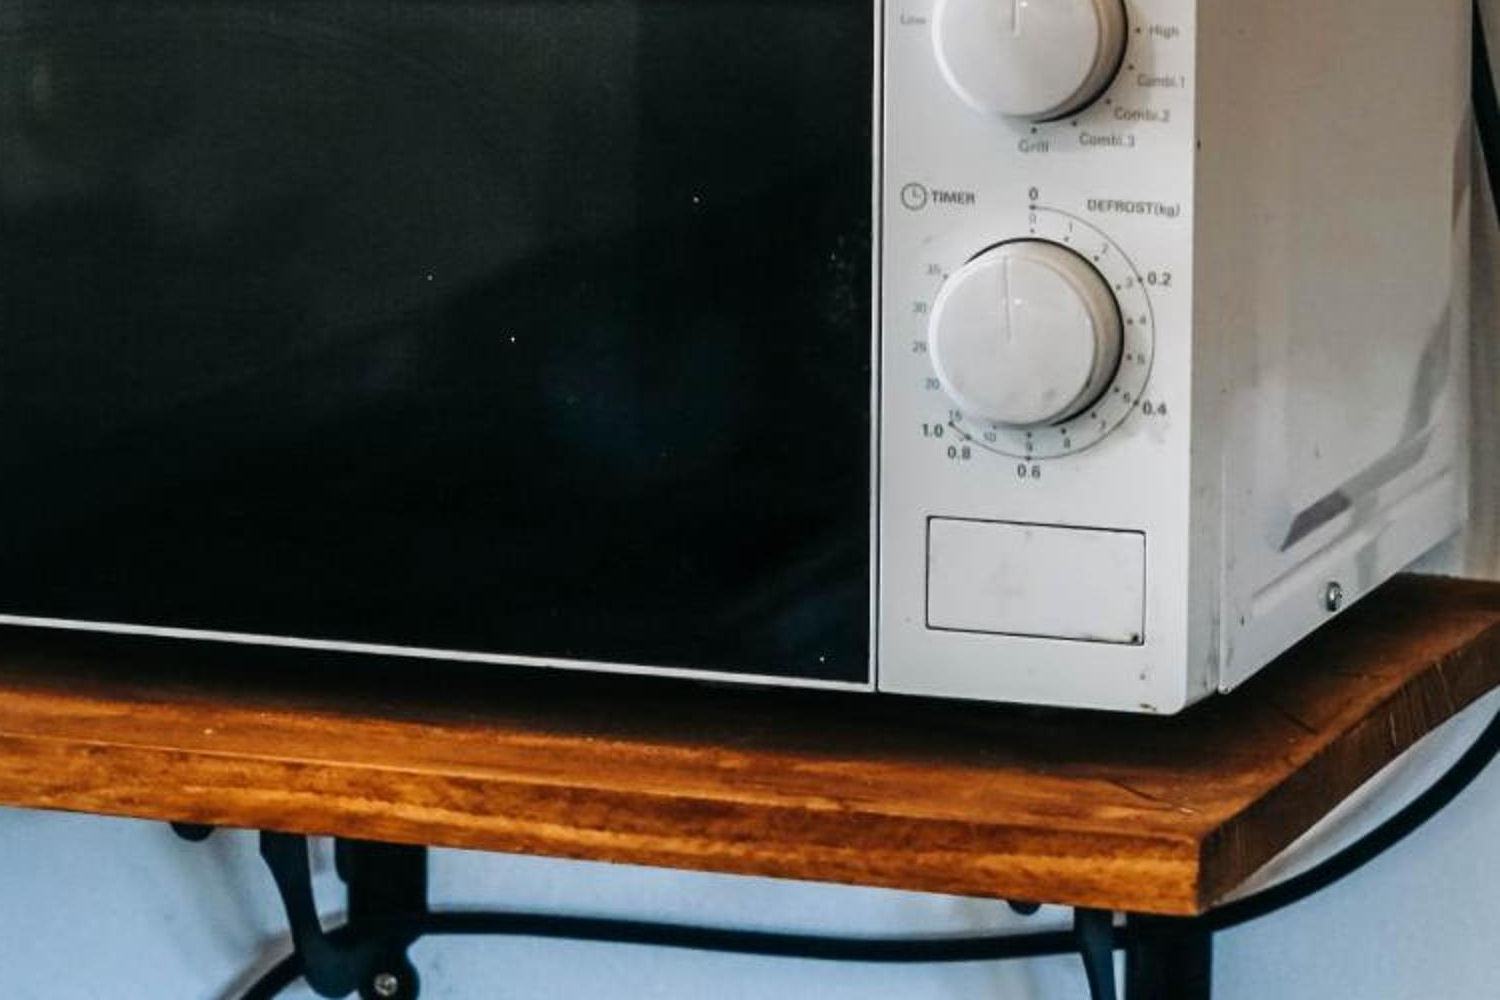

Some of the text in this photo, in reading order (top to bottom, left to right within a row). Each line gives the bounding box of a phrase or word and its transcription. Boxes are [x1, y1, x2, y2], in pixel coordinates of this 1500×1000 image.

[1148, 24, 1180, 39] High
[1018, 139, 1049, 152] Grill
[931, 190, 975, 205] TIMER
[1028, 186, 1039, 201] 0
[1147, 271, 1172, 287] 0.2
[1142, 400, 1167, 416] 0.4
[922, 423, 944, 438] 1.0
